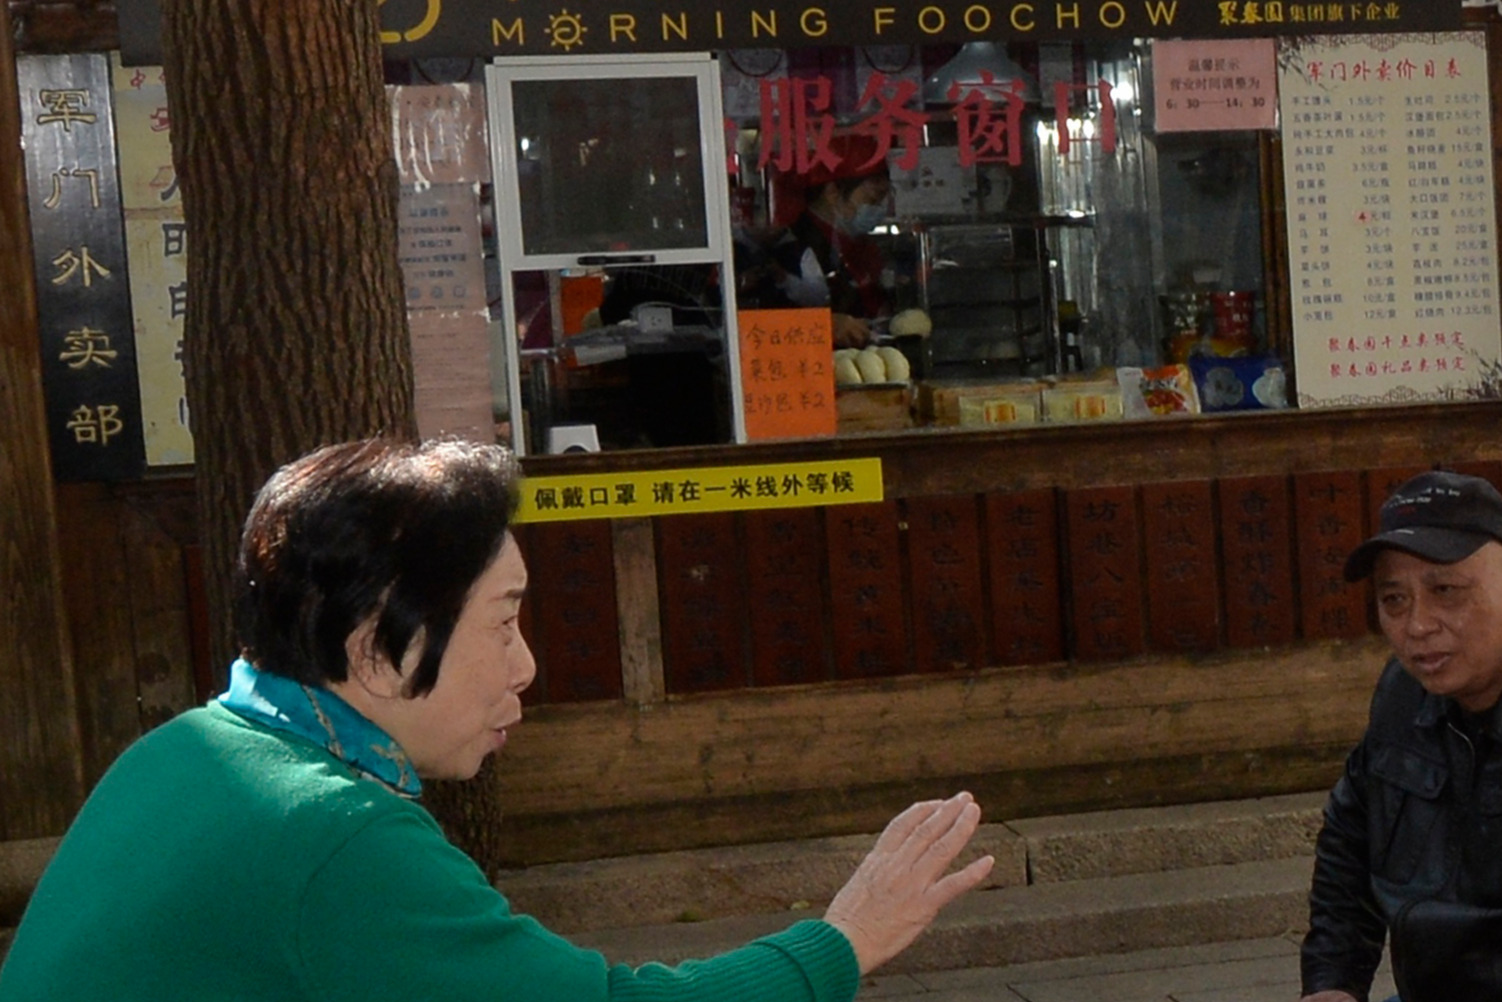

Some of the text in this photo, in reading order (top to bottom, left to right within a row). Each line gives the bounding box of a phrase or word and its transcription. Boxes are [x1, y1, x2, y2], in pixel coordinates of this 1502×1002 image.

[873, 1, 1178, 35] FOOCHOW
[725, 69, 1116, 175] 服务窗口
[36, 87, 123, 444] 军门外卖部
[534, 471, 856, 510] 佩戴口罩 请在一米线外等候
